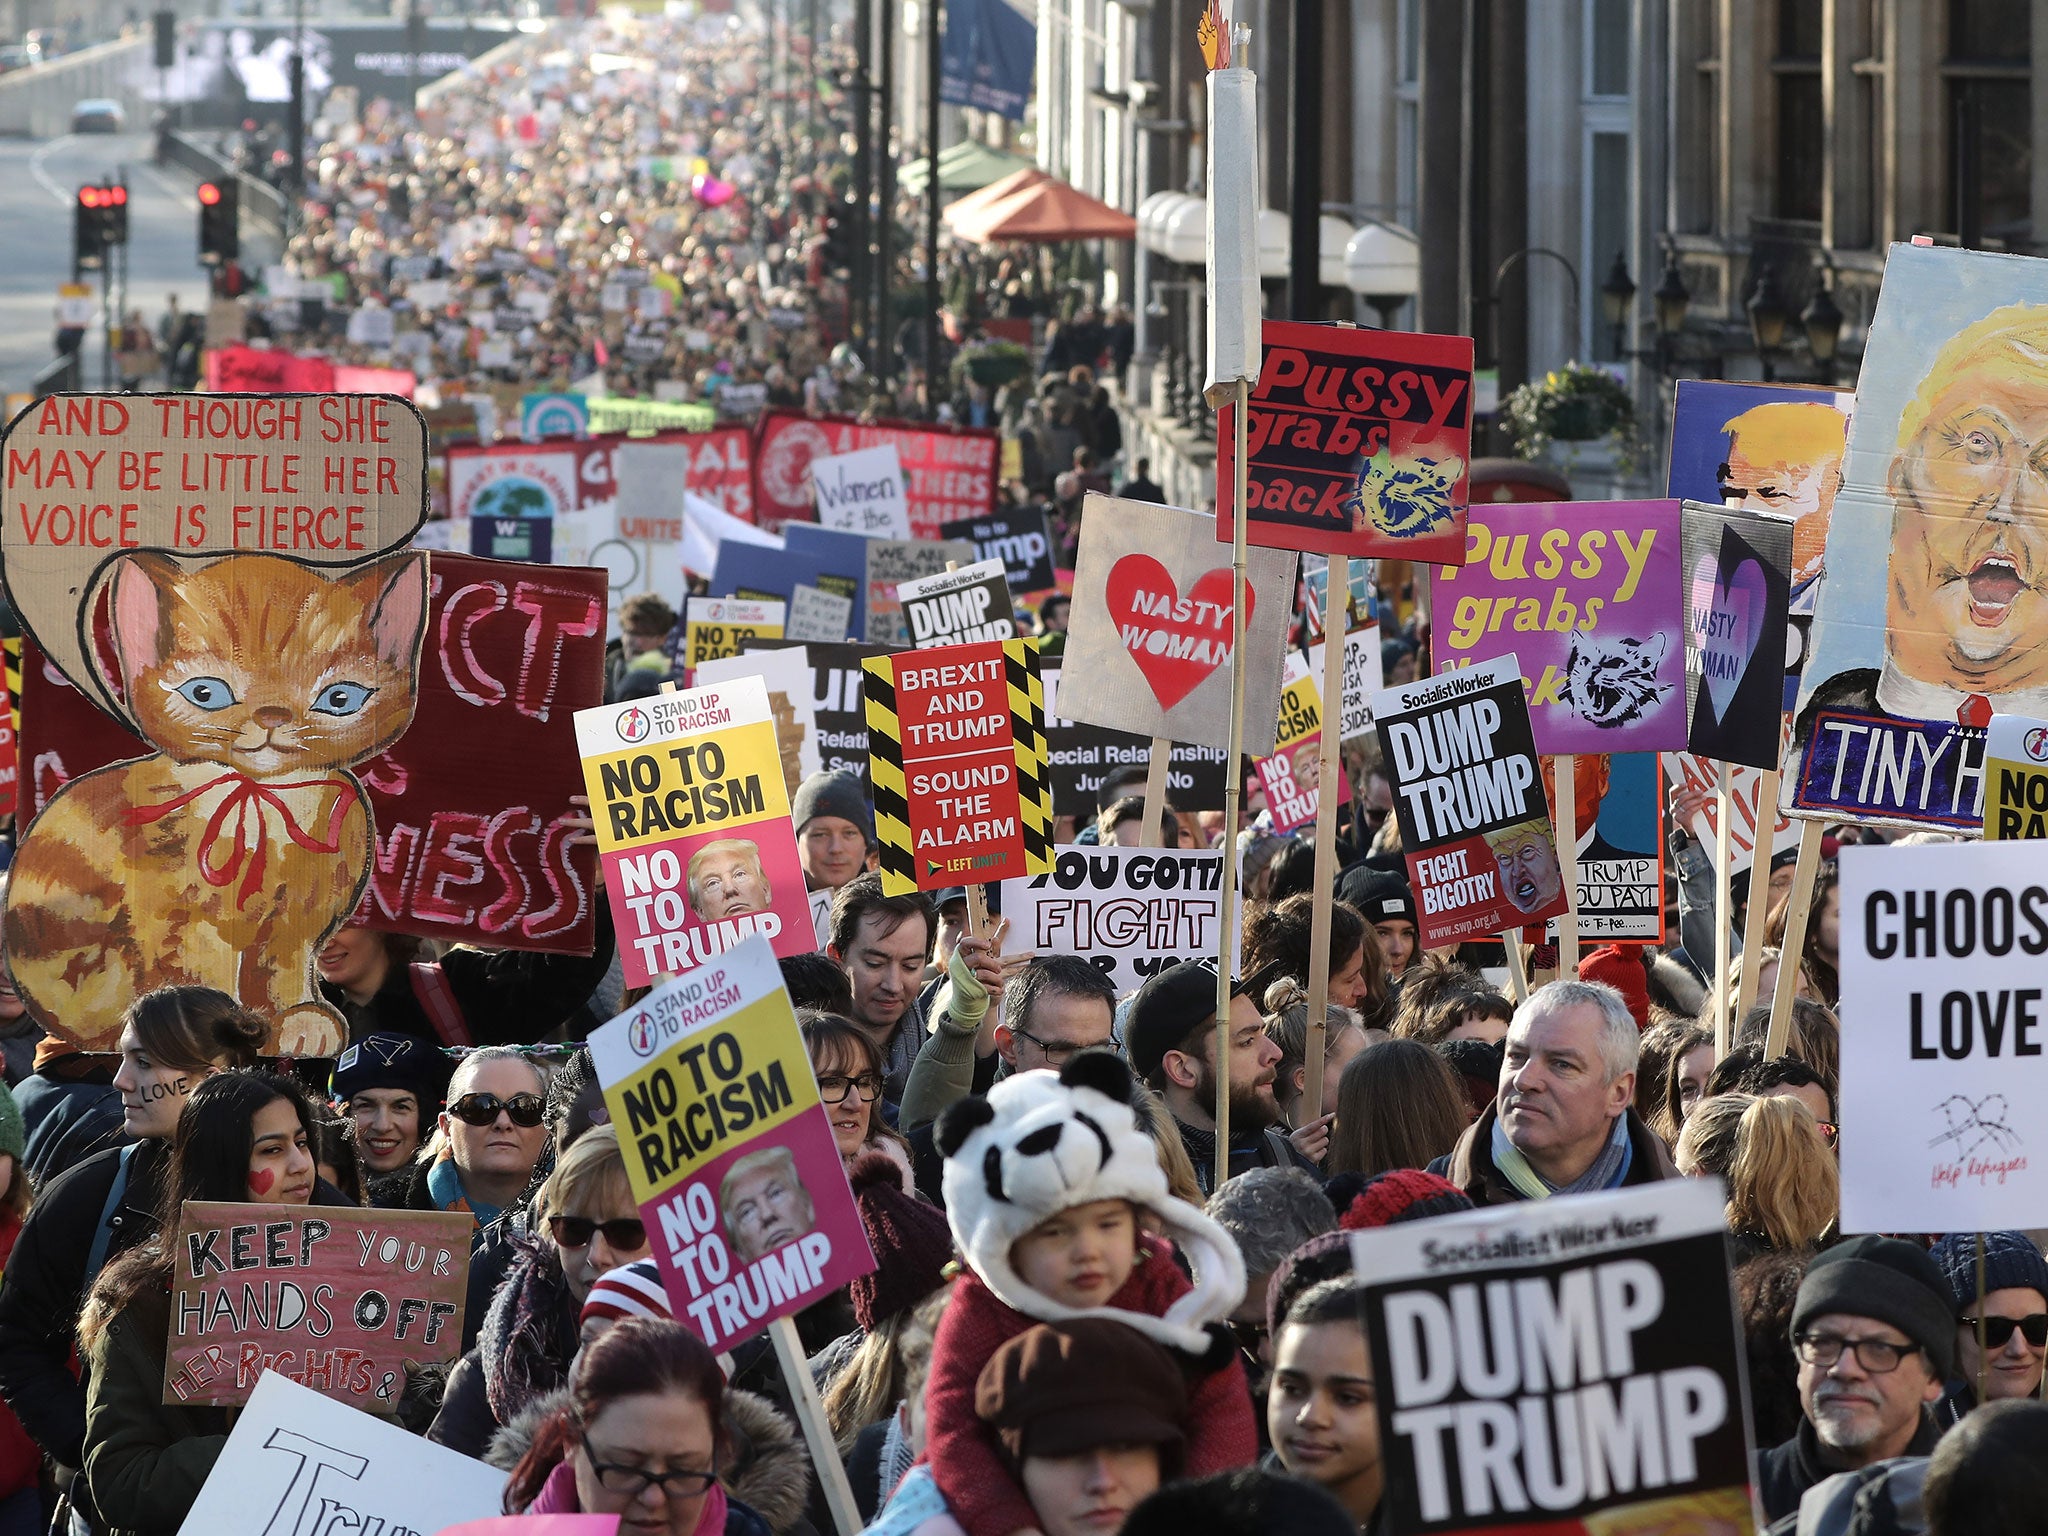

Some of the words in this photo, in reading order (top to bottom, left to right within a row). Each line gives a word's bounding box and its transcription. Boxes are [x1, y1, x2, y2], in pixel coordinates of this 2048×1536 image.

[1251, 348, 1467, 444] Pussy
[38, 398, 129, 437] AND
[154, 398, 301, 442] THOUGH
[321, 397, 390, 444] SHE
[1235, 410, 1389, 457] grabs
[8, 449, 106, 491] MAY
[121, 452, 161, 491] BE
[182, 453, 299, 494] LITTLE
[324, 456, 400, 496] HER
[816, 465, 895, 508] Women
[911, 468, 988, 501] THERS
[20, 503, 139, 547] VOICE
[174, 504, 205, 547] IS
[233, 504, 365, 550] FIERCE
[620, 517, 683, 540] UNITE
[1439, 523, 1658, 605] Pussy
[909, 586, 991, 641] DUMP
[1131, 590, 1233, 629] NASTY
[1447, 588, 1604, 650] grabs
[1691, 606, 1737, 640] NASTY
[695, 625, 723, 645] NO
[1122, 624, 1233, 666] WOMAN
[901, 659, 1001, 691] BREXIT
[1685, 645, 1740, 681] WOMAN
[652, 698, 697, 719] STAND
[700, 694, 719, 710] UP
[656, 718, 675, 735] TO
[678, 707, 731, 731] RACISM
[926, 690, 984, 716] AND
[1340, 706, 1374, 735] ESIDEN
[1343, 691, 1362, 709] FOR
[907, 714, 1006, 745] TRUMP
[1387, 698, 1501, 782] DUMP
[600, 755, 661, 801] NO
[669, 742, 725, 785] TO
[912, 764, 1010, 796] SOUND
[1048, 746, 1099, 769] pecial
[1166, 771, 1194, 789] No
[1261, 754, 1290, 784] NO
[608, 775, 765, 841] RACISM
[936, 793, 991, 819] THE
[1268, 776, 1296, 805] TO
[1275, 788, 1319, 826] TRU
[1400, 753, 1533, 843] TRUMP
[2000, 768, 2048, 812] NO
[917, 816, 1015, 848] ALARM
[618, 850, 681, 896] NO
[1416, 849, 1468, 887] FIGHT
[1577, 861, 1649, 883] TRUMP
[625, 890, 685, 935] TO
[1422, 871, 1495, 916] BIGOTRY
[1577, 886, 1602, 907] OU
[1611, 886, 1652, 908] PAY!
[632, 912, 782, 976] TRUMP
[1036, 898, 1216, 950] FIGHT
[1428, 915, 1501, 941] www.swp.org.uk
[1865, 886, 2048, 960] CHOOS
[654, 986, 702, 1020] STAND
[705, 970, 726, 994] UP
[660, 1016, 679, 1039] TO
[681, 988, 742, 1027] RACISM
[1909, 989, 2042, 1060] LOVE
[140, 1077, 191, 1103] LOVE
[622, 1068, 677, 1137] NO
[679, 1032, 742, 1092] TO
[637, 1060, 793, 1185] RACISM
[1931, 1163, 1962, 1189] Help
[1967, 1156, 2028, 1186] Refugees
[656, 1182, 717, 1254] NO
[188, 1219, 331, 1279] KEEP
[356, 1229, 451, 1277] YOUR
[1422, 1228, 1550, 1268] Socialist
[1551, 1214, 1661, 1251] Worker
[671, 1234, 730, 1298] TO
[687, 1232, 832, 1347] TRUMP
[178, 1281, 334, 1338] HANDS
[353, 1289, 457, 1344] OFF
[1383, 1258, 1666, 1409] DUMP
[169, 1344, 234, 1402] HER
[236, 1342, 377, 1396] RIGHTS
[374, 1371, 397, 1405] &
[1391, 1366, 1730, 1524] TRUMP
